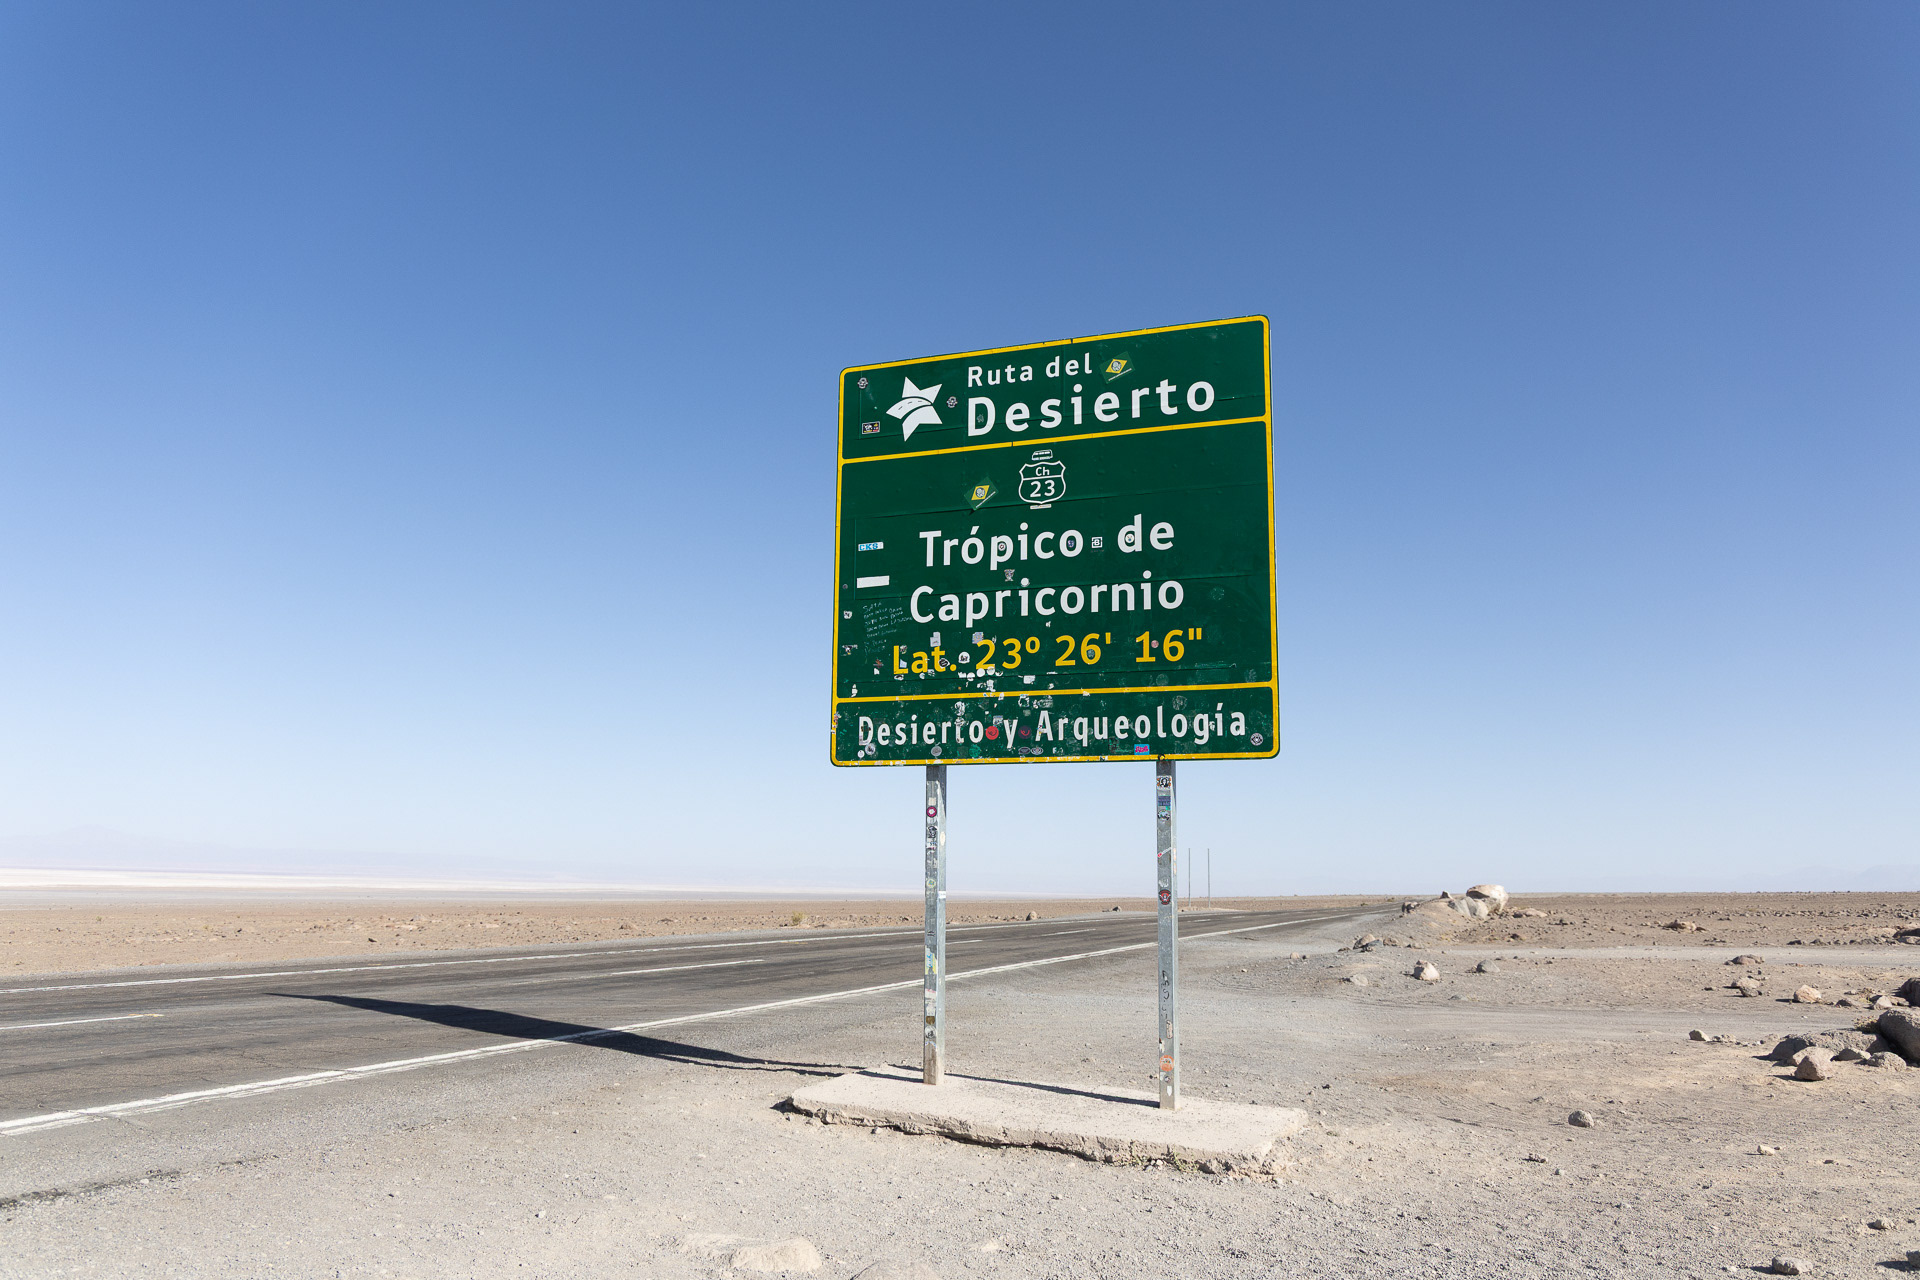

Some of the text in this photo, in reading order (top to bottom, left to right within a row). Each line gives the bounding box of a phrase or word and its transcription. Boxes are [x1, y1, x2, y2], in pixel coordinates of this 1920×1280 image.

[967, 352, 1093, 387] Ruta del
[967, 379, 1215, 437] Desierto
[1029, 479, 1055, 498] 23
[1035, 466, 1050, 477] Ch
[919, 513, 1175, 571] Trópico de
[910, 570, 1185, 628] Capricornio
[893, 645, 957, 675] Lat.
[1055, 632, 1111, 666] 26'
[1135, 627, 1202, 663] 16"
[858, 702, 1246, 749] Desierto y Arqueología
